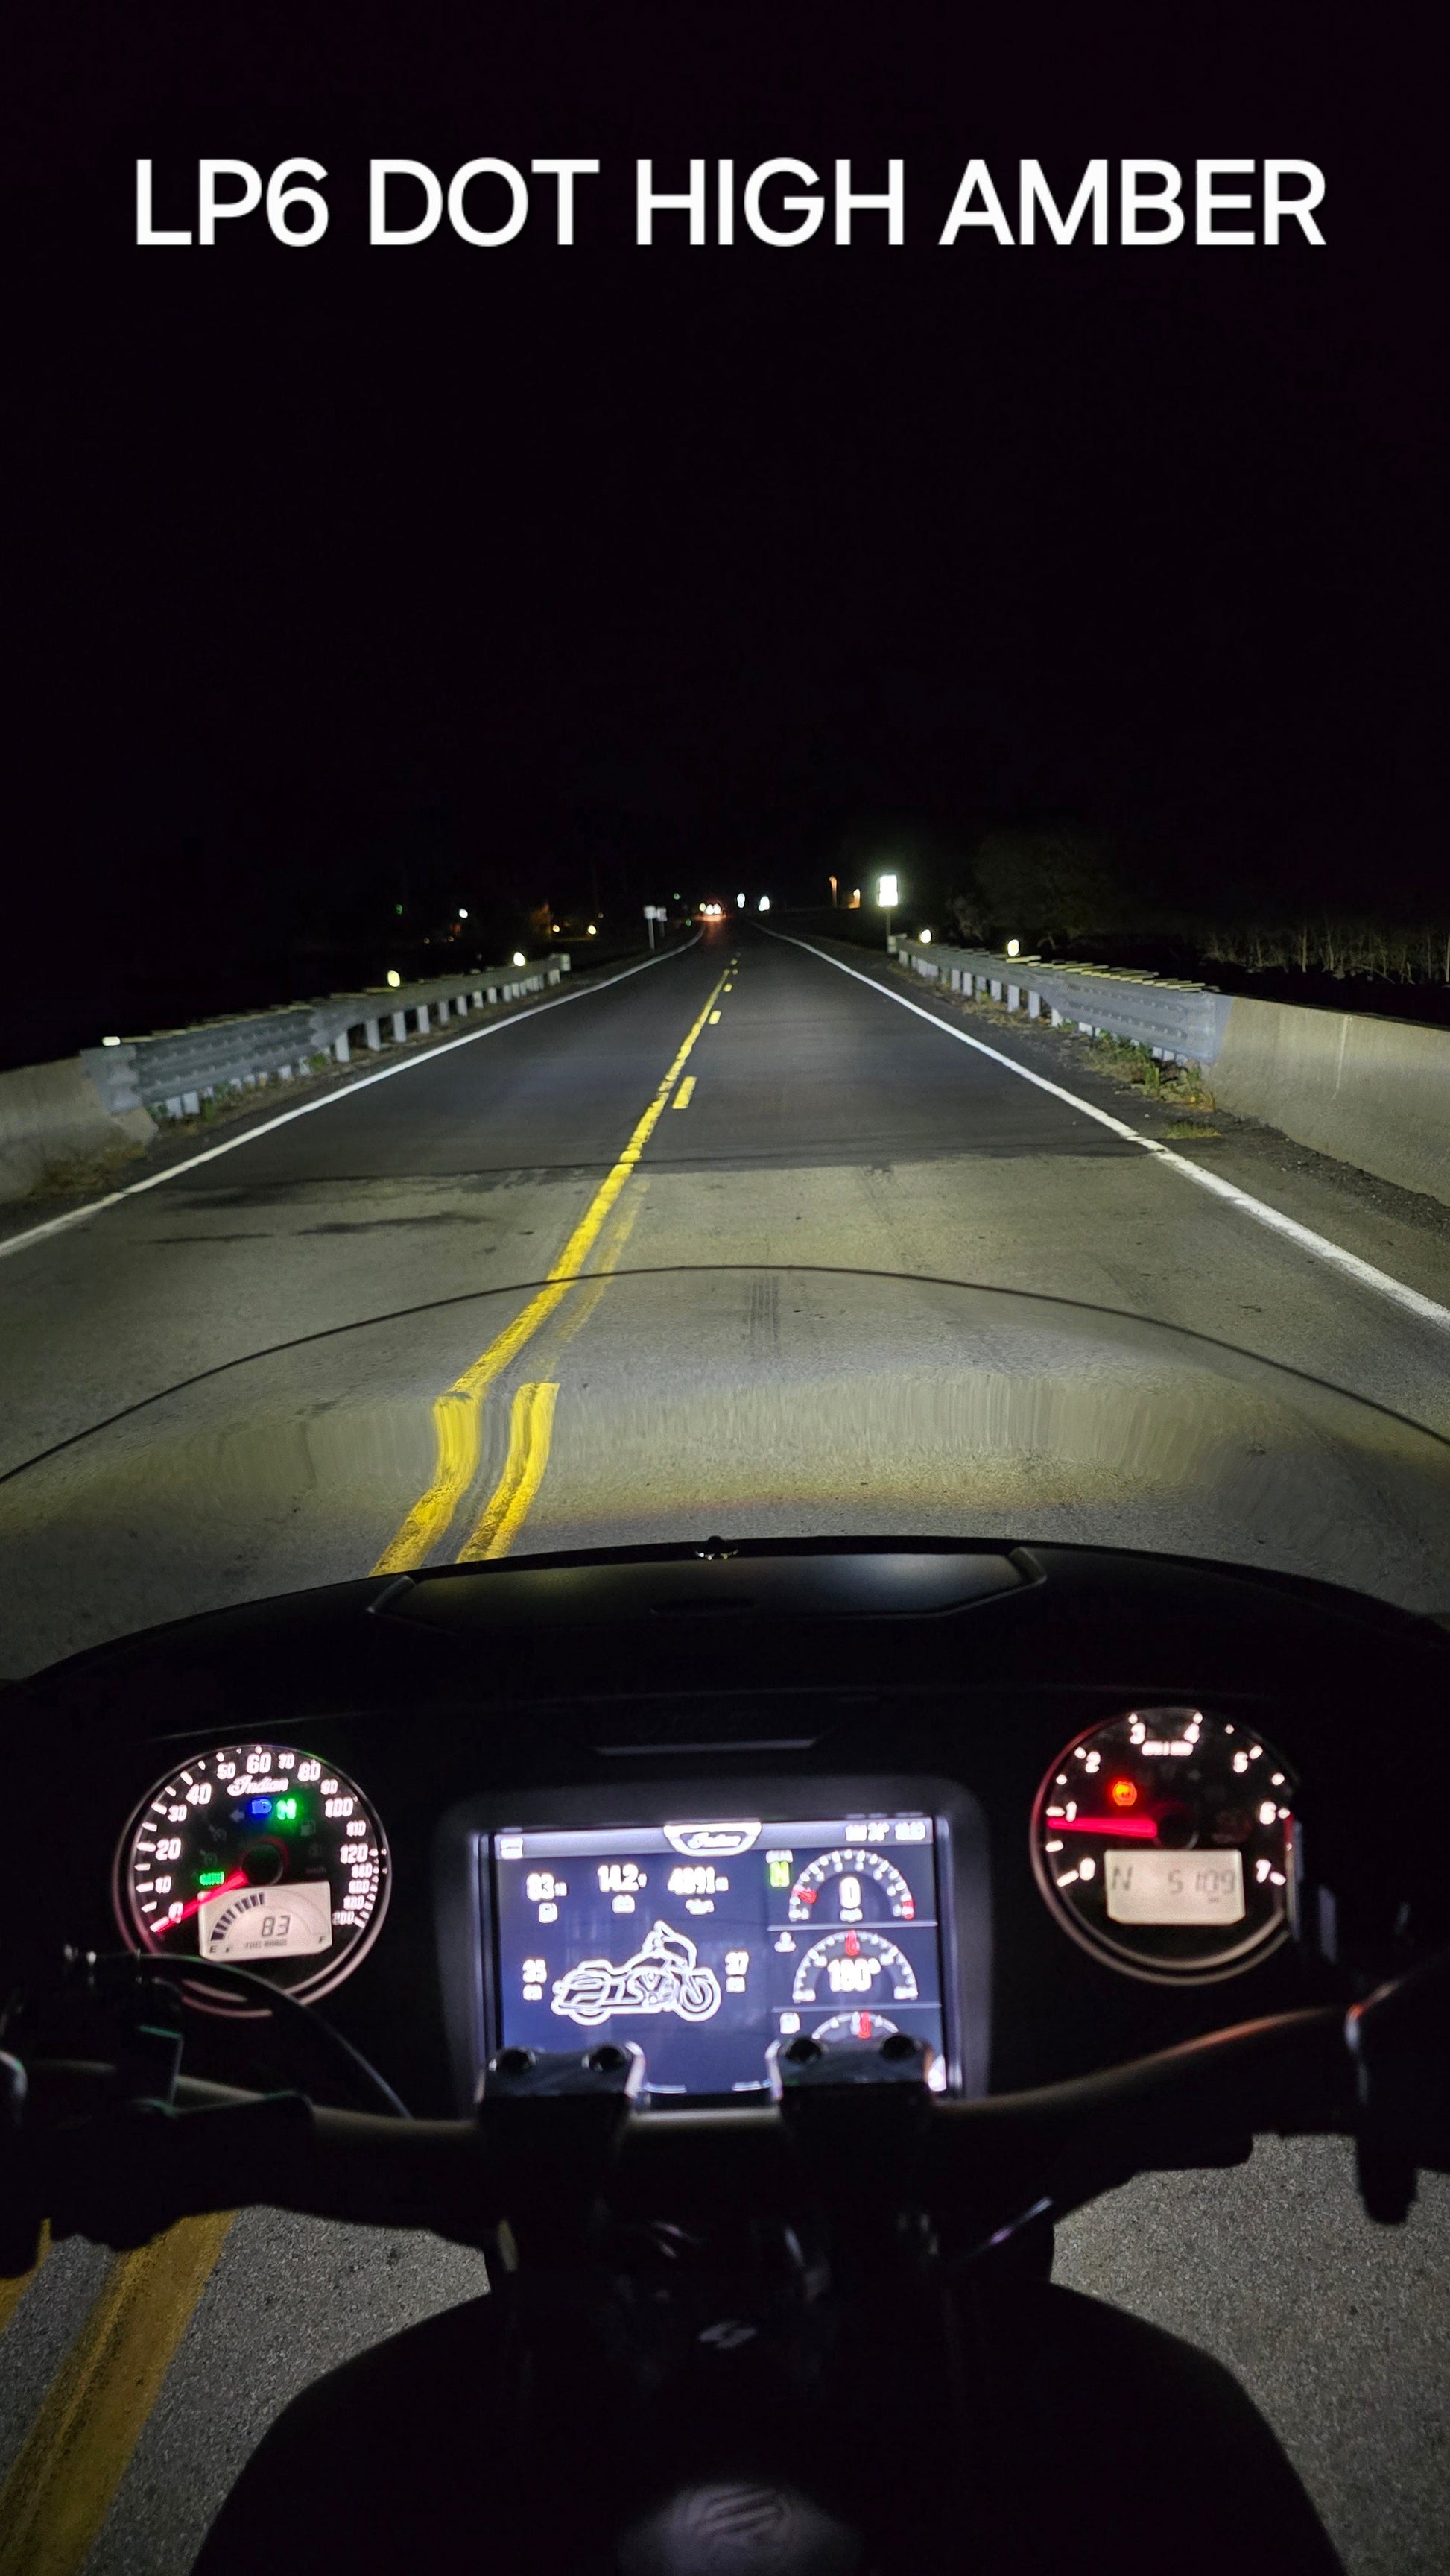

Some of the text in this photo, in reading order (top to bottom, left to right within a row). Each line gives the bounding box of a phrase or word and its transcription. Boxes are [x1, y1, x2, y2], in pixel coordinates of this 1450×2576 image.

[1130, 1723, 1146, 1745] 3
[1184, 1723, 1200, 1743] 4
[216, 1761, 237, 1780] 50
[246, 1752, 272, 1774] 60
[278, 1752, 295, 1770] 70
[297, 1761, 322, 1782] 80
[1085, 1751, 1101, 1773] 2
[186, 1782, 212, 1805] 40
[227, 1774, 290, 1796] Indian
[168, 1804, 188, 1822] 30
[276, 1799, 297, 1820] N
[325, 1796, 354, 1818] 100
[1066, 1801, 1078, 1822] 1
[155, 1837, 182, 1860] 20
[340, 1843, 369, 1864] 120
[770, 1860, 790, 1887] N
[1112, 1866, 1133, 1891] N
[1256, 1858, 1272, 1883] 7
[155, 1875, 172, 1894] 10
[526, 1872, 555, 1901] 83
[839, 1876, 861, 1909] 0
[168, 1901, 184, 1924] 0
[262, 1915, 291, 1937] 83
